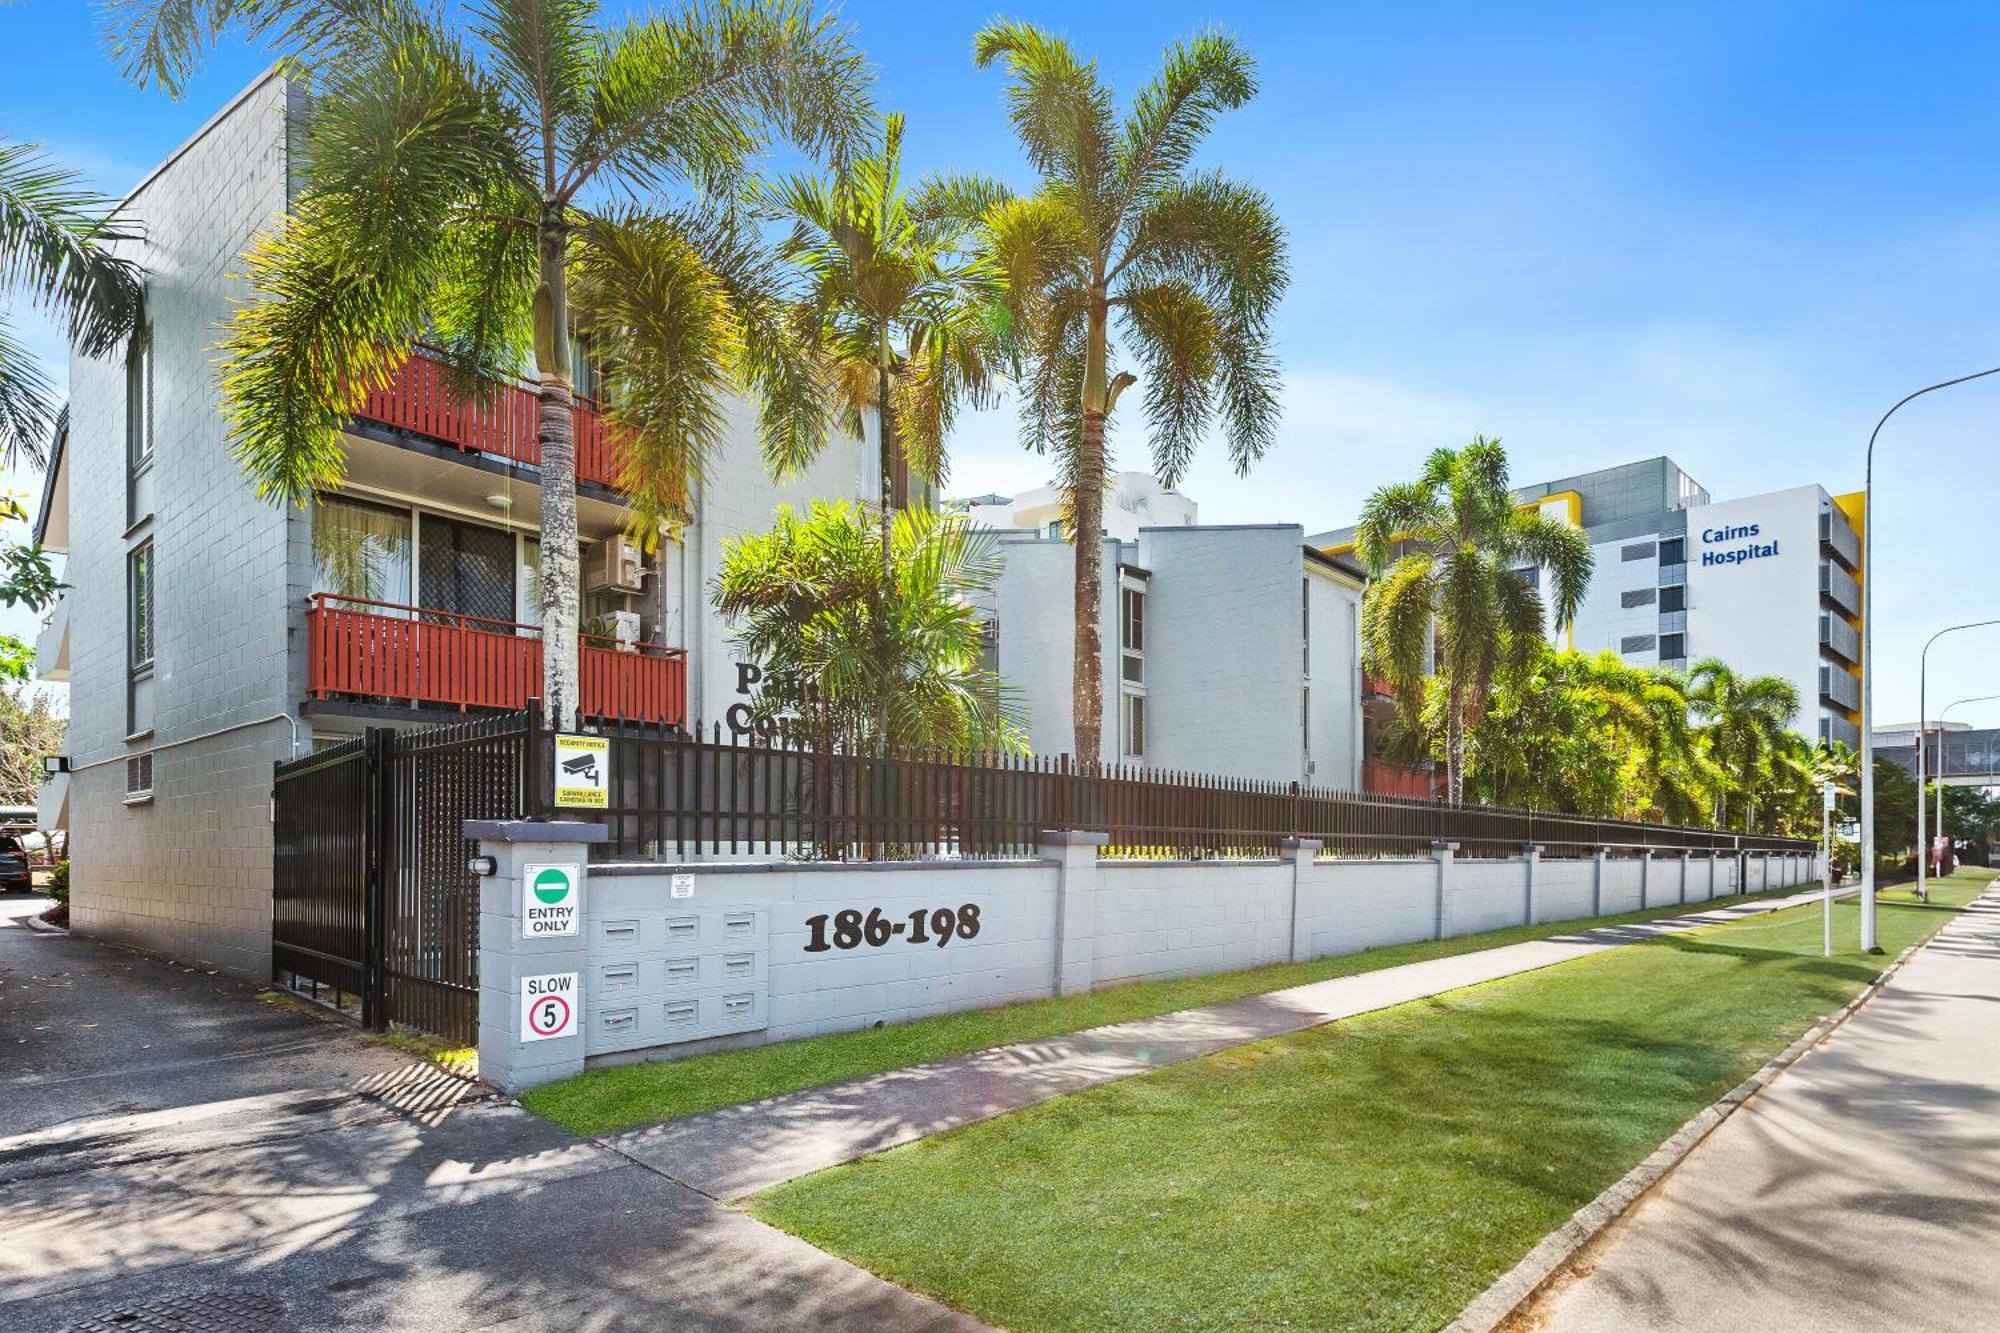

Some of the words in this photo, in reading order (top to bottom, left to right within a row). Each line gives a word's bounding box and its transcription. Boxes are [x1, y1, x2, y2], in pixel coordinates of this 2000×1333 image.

[1702, 524, 1760, 543] Cairns
[1702, 540, 1779, 565] Hospital
[529, 907, 573, 919] ENTRY
[533, 920, 569, 932] ONLY
[803, 903, 981, 952] 186-198
[528, 976, 572, 995] SLOW
[543, 1004, 556, 1028] 5
